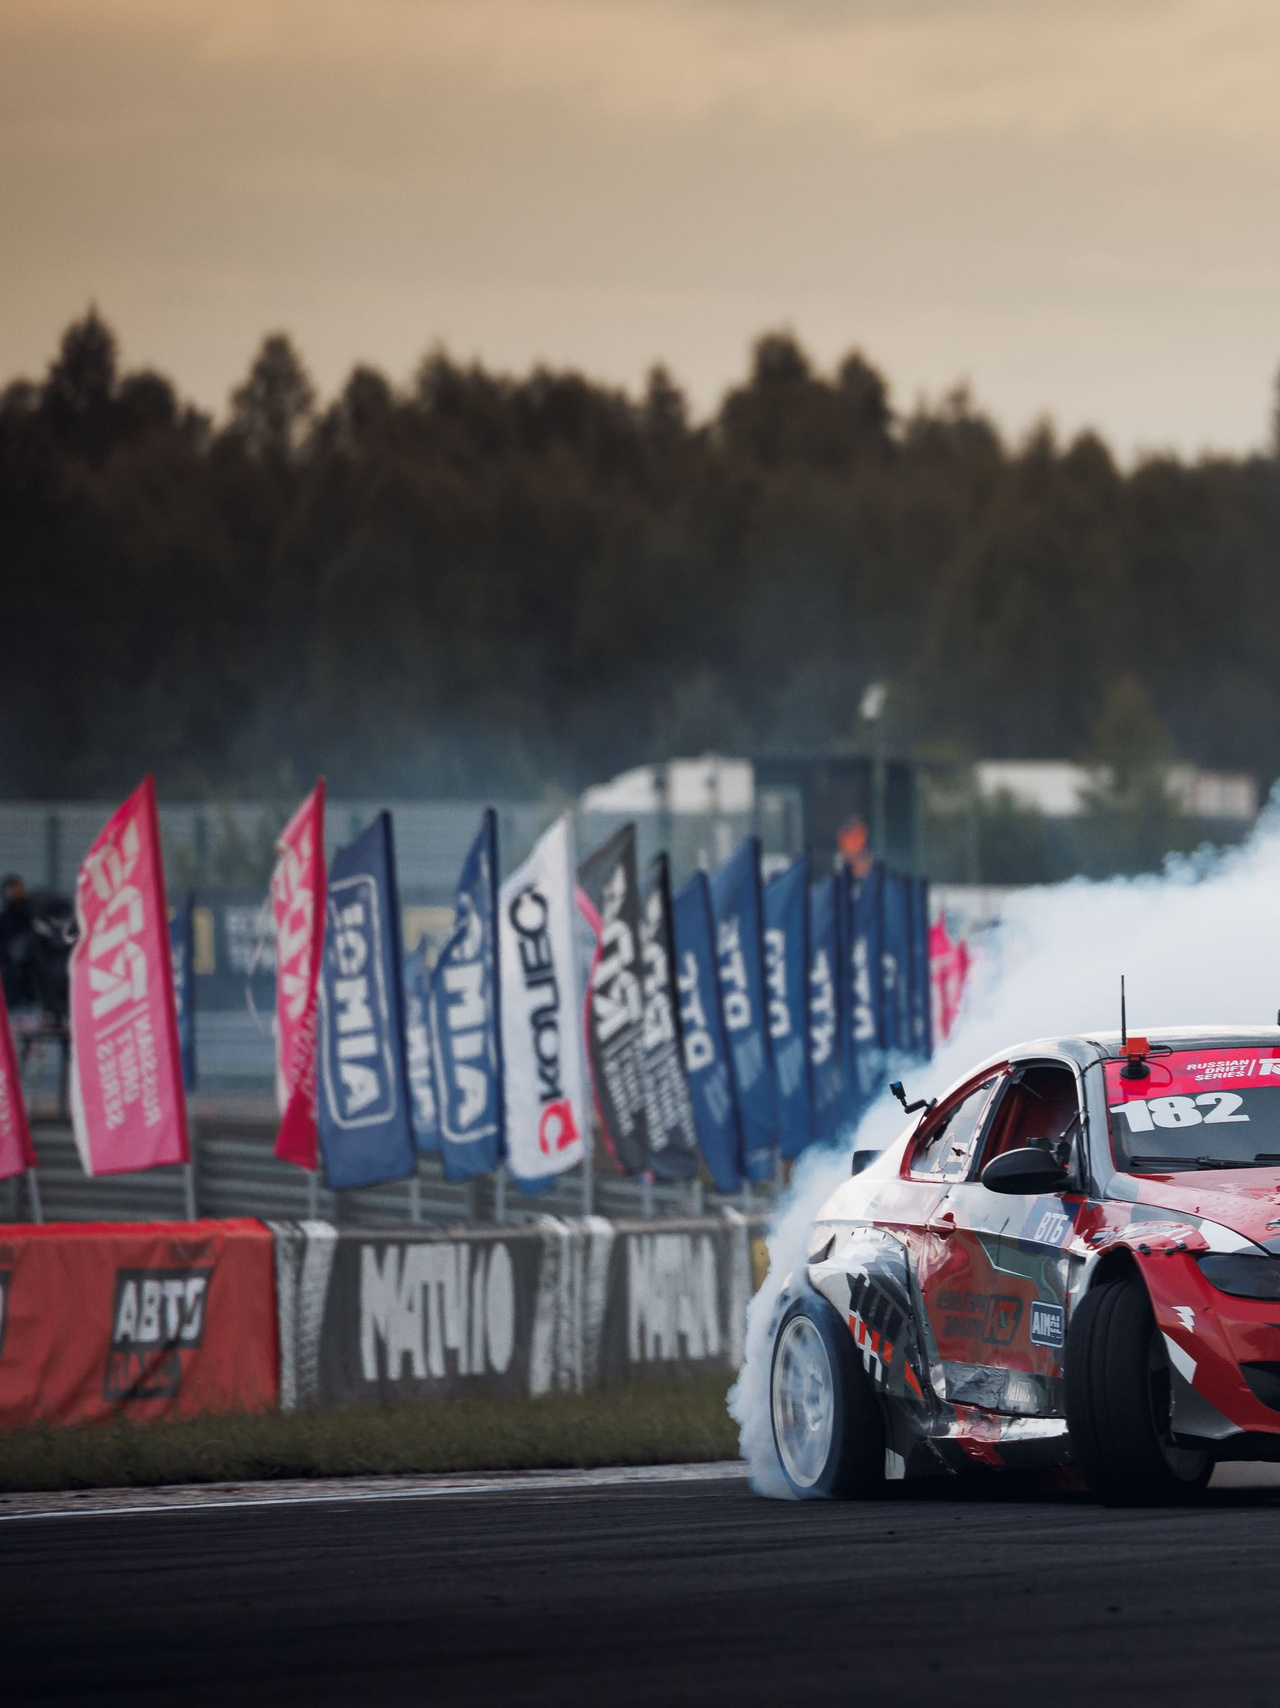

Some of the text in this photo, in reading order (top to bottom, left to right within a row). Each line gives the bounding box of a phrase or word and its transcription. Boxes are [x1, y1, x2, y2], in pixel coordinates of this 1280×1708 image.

[1187, 1059, 1249, 1071] RUSSIAN
[1206, 1065, 1245, 1075] DRIFT
[1195, 1070, 1245, 1081] SERIES
[1110, 1092, 1250, 1133] 182
[1034, 1212, 1069, 1243] ВТБ
